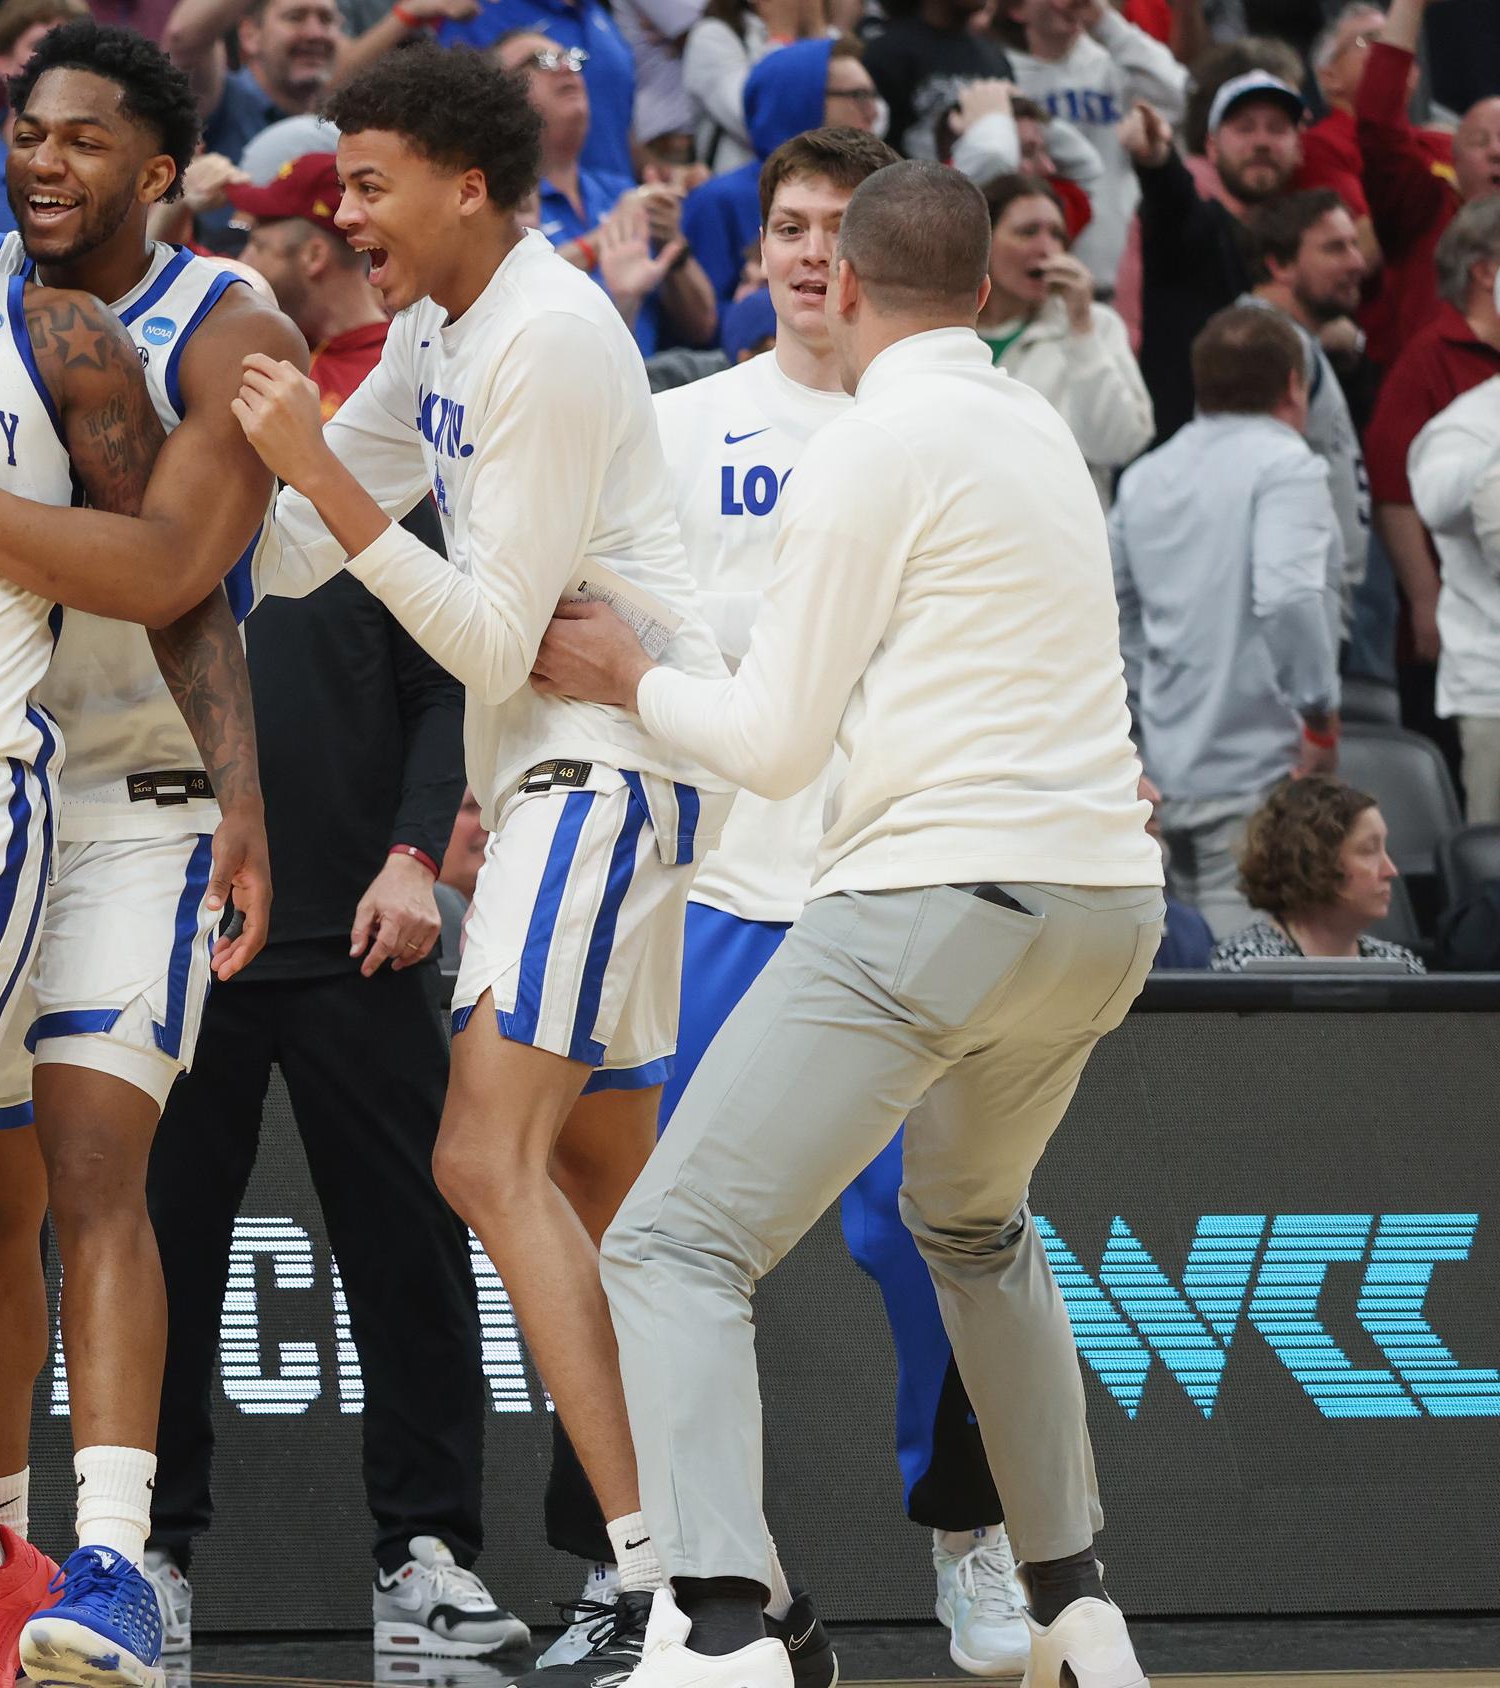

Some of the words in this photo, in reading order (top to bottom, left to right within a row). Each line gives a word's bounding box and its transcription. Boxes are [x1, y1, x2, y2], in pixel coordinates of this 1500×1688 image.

[146, 325, 173, 339] NCAA
[721, 465, 794, 516] LO
[559, 767, 575, 778] 48
[191, 779, 205, 790] 48
[1030, 1213, 1500, 1420] WCC
